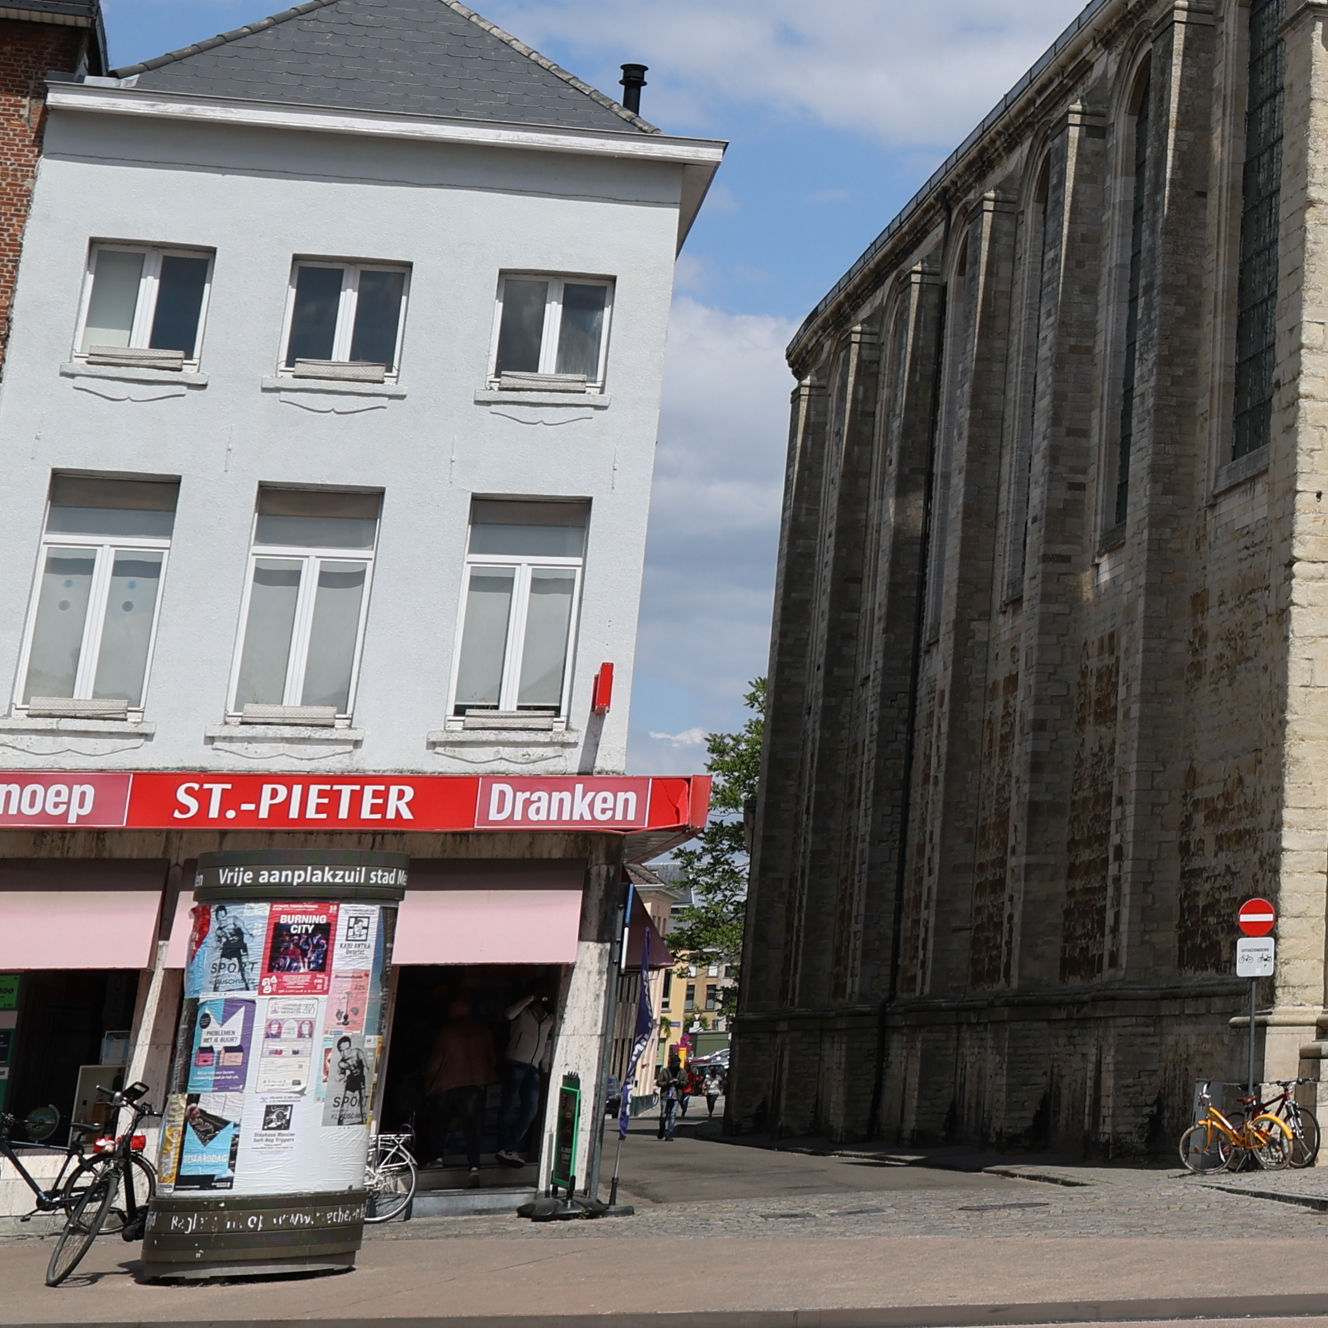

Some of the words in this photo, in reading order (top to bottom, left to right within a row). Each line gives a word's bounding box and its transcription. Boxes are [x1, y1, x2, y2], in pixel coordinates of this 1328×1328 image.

[172, 782, 416, 820] ST.-PIETER
[487, 783, 638, 821] Dranken
[218, 868, 253, 887] Vrije
[258, 866, 365, 886] aanplakzuil
[369, 868, 397, 885] stad
[279, 914, 328, 924] BURNING
[290, 925, 315, 934] CITY
[210, 961, 259, 974] SPORT
